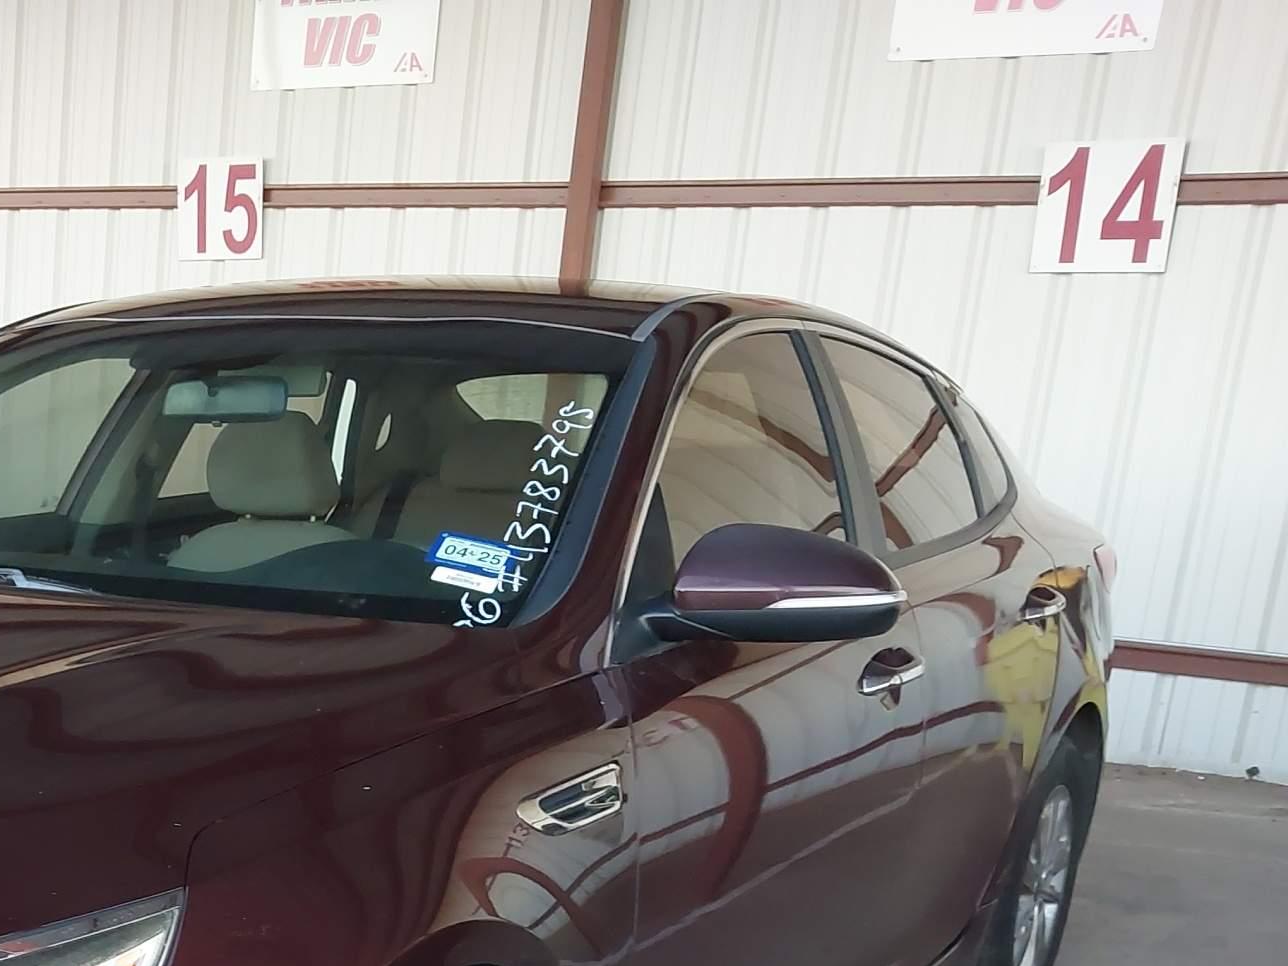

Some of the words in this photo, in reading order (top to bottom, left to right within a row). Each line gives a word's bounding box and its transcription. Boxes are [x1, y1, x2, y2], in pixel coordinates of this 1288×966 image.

[304, 13, 382, 68] VIC
[184, 164, 258, 254] 15
[1048, 145, 1165, 263] 14
